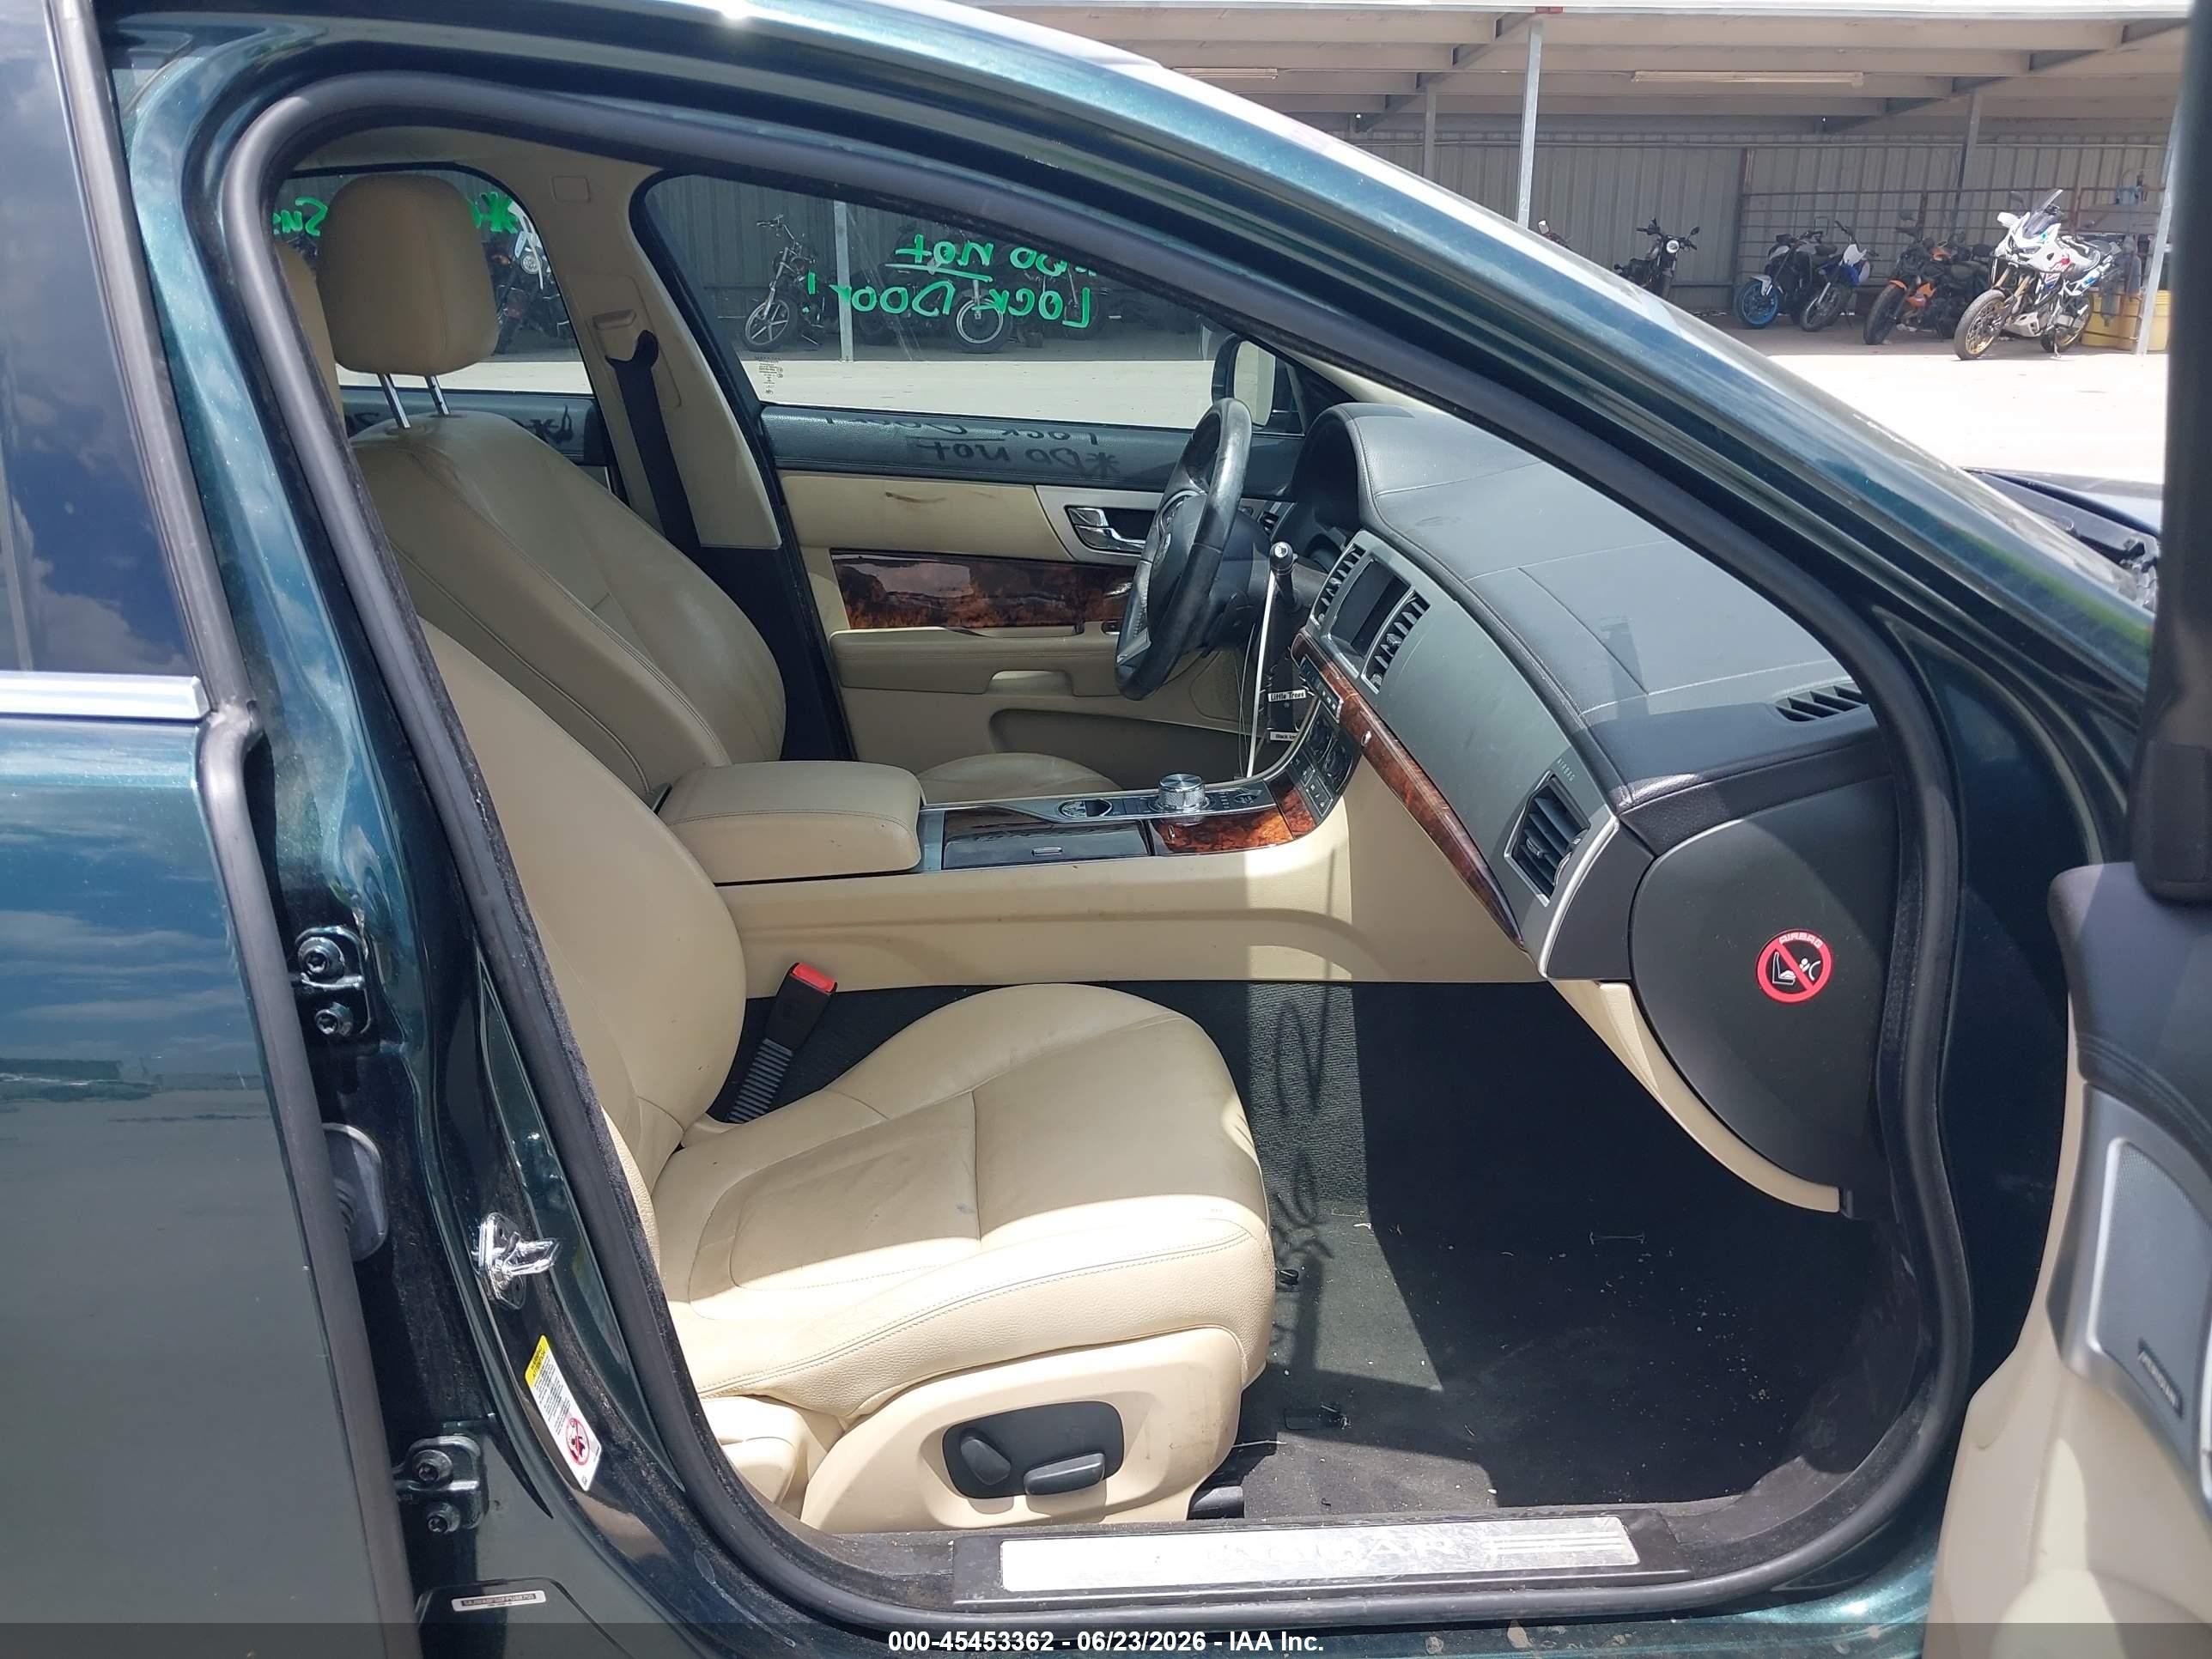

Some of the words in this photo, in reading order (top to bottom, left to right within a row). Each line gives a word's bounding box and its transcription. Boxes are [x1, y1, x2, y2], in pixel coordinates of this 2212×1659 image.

[1270, 692, 1287, 702] Little
[1557, 757, 1576, 782] AIRBAG
[1778, 932, 1823, 949] AIRBAG
